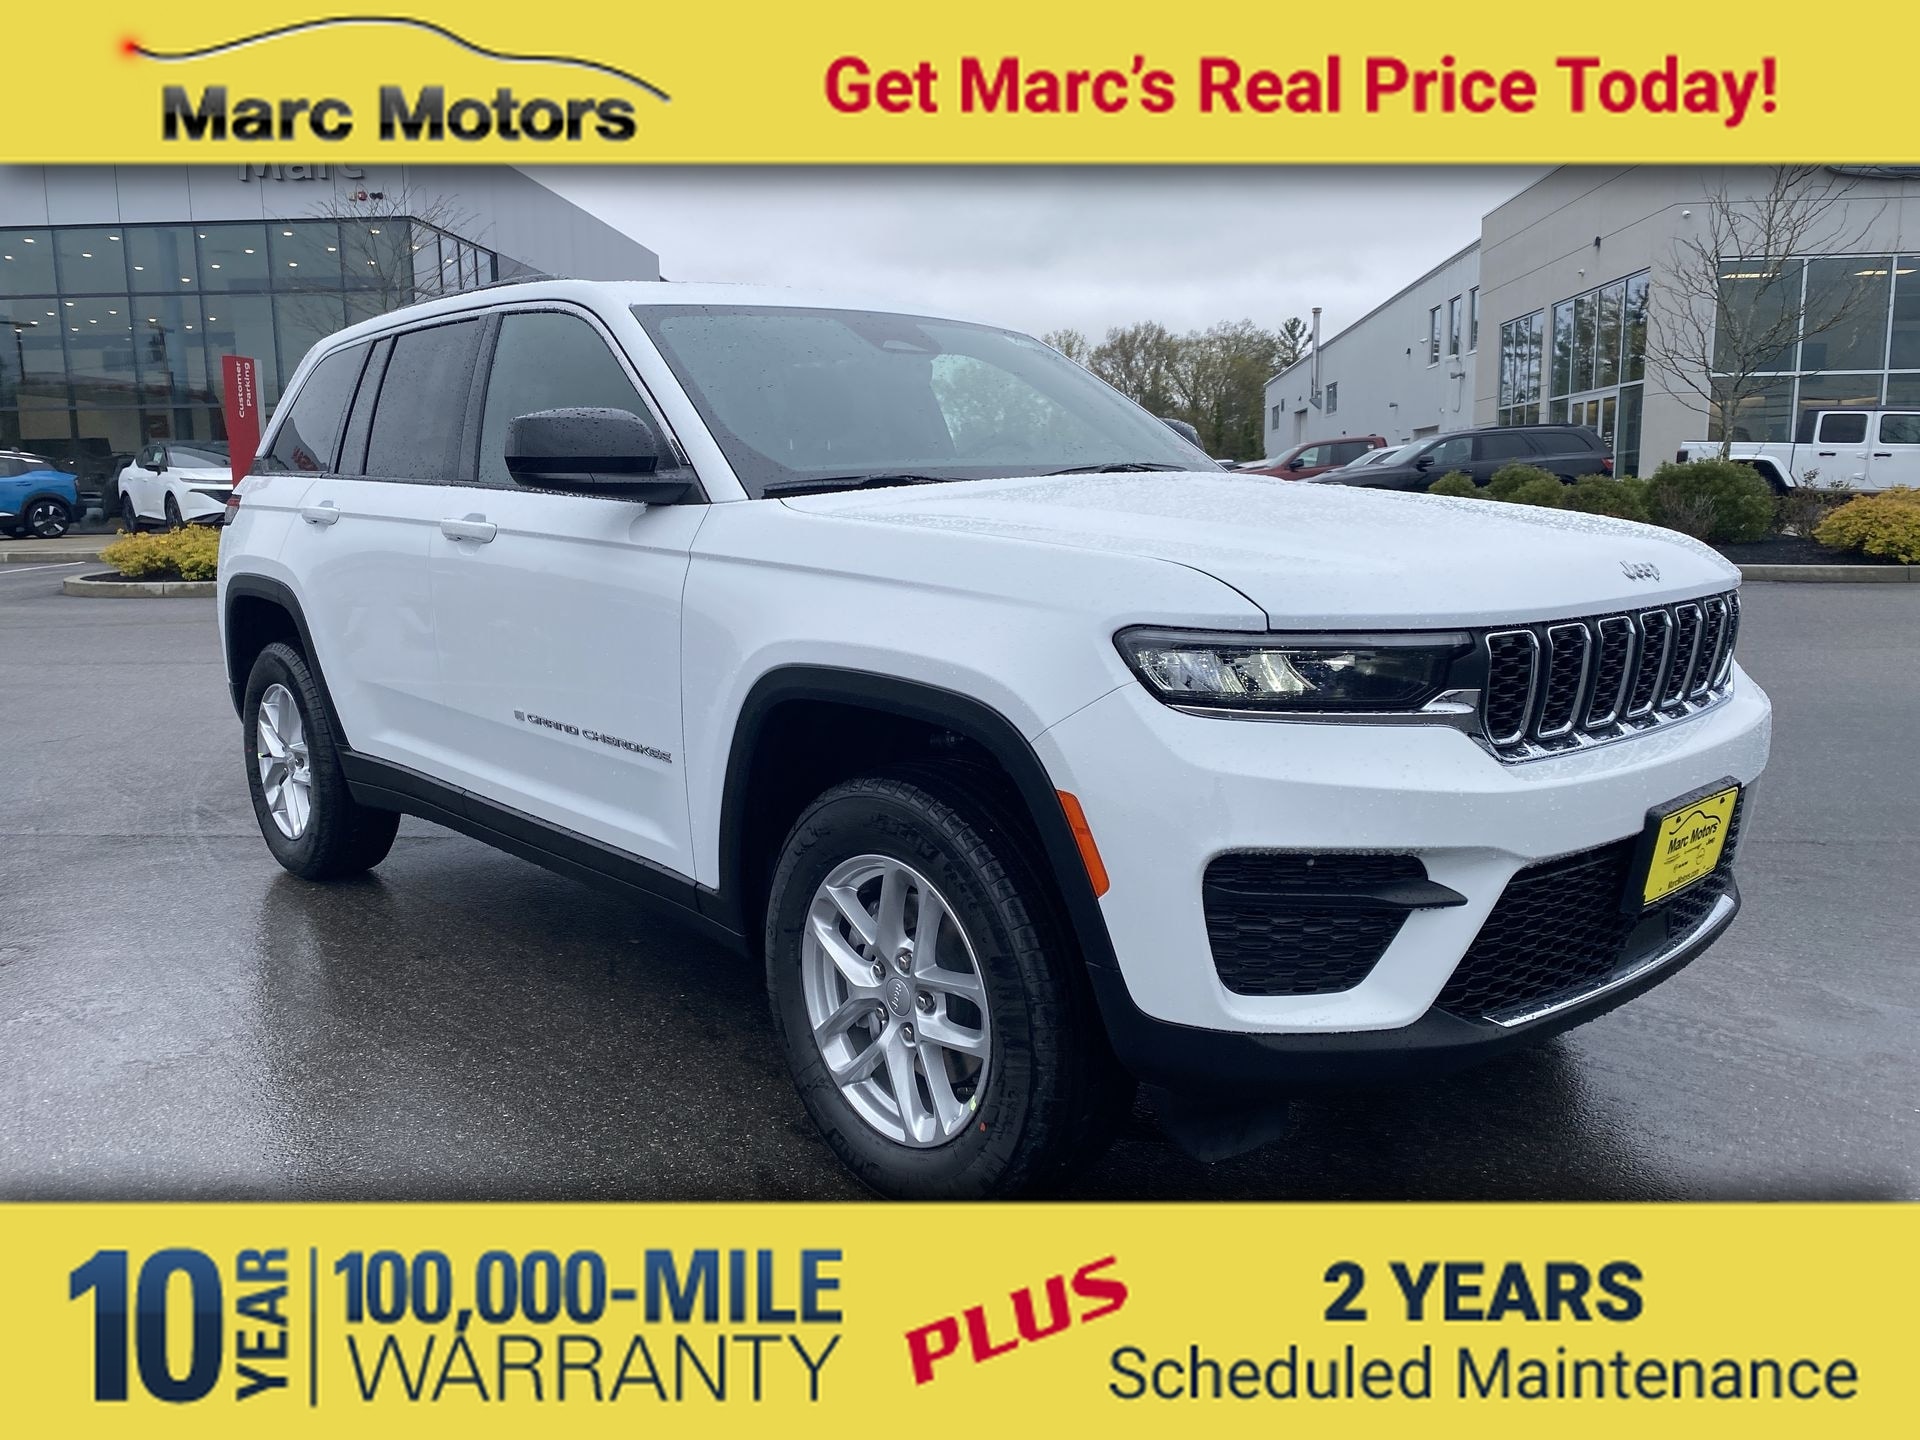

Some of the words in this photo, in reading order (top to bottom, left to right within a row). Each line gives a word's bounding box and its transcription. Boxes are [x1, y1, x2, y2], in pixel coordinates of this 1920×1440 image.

[236, 361, 245, 418] Customer
[1620, 560, 1660, 582] Jeep
[1667, 836, 1689, 854] Marc
[1690, 822, 1718, 844] Motors
